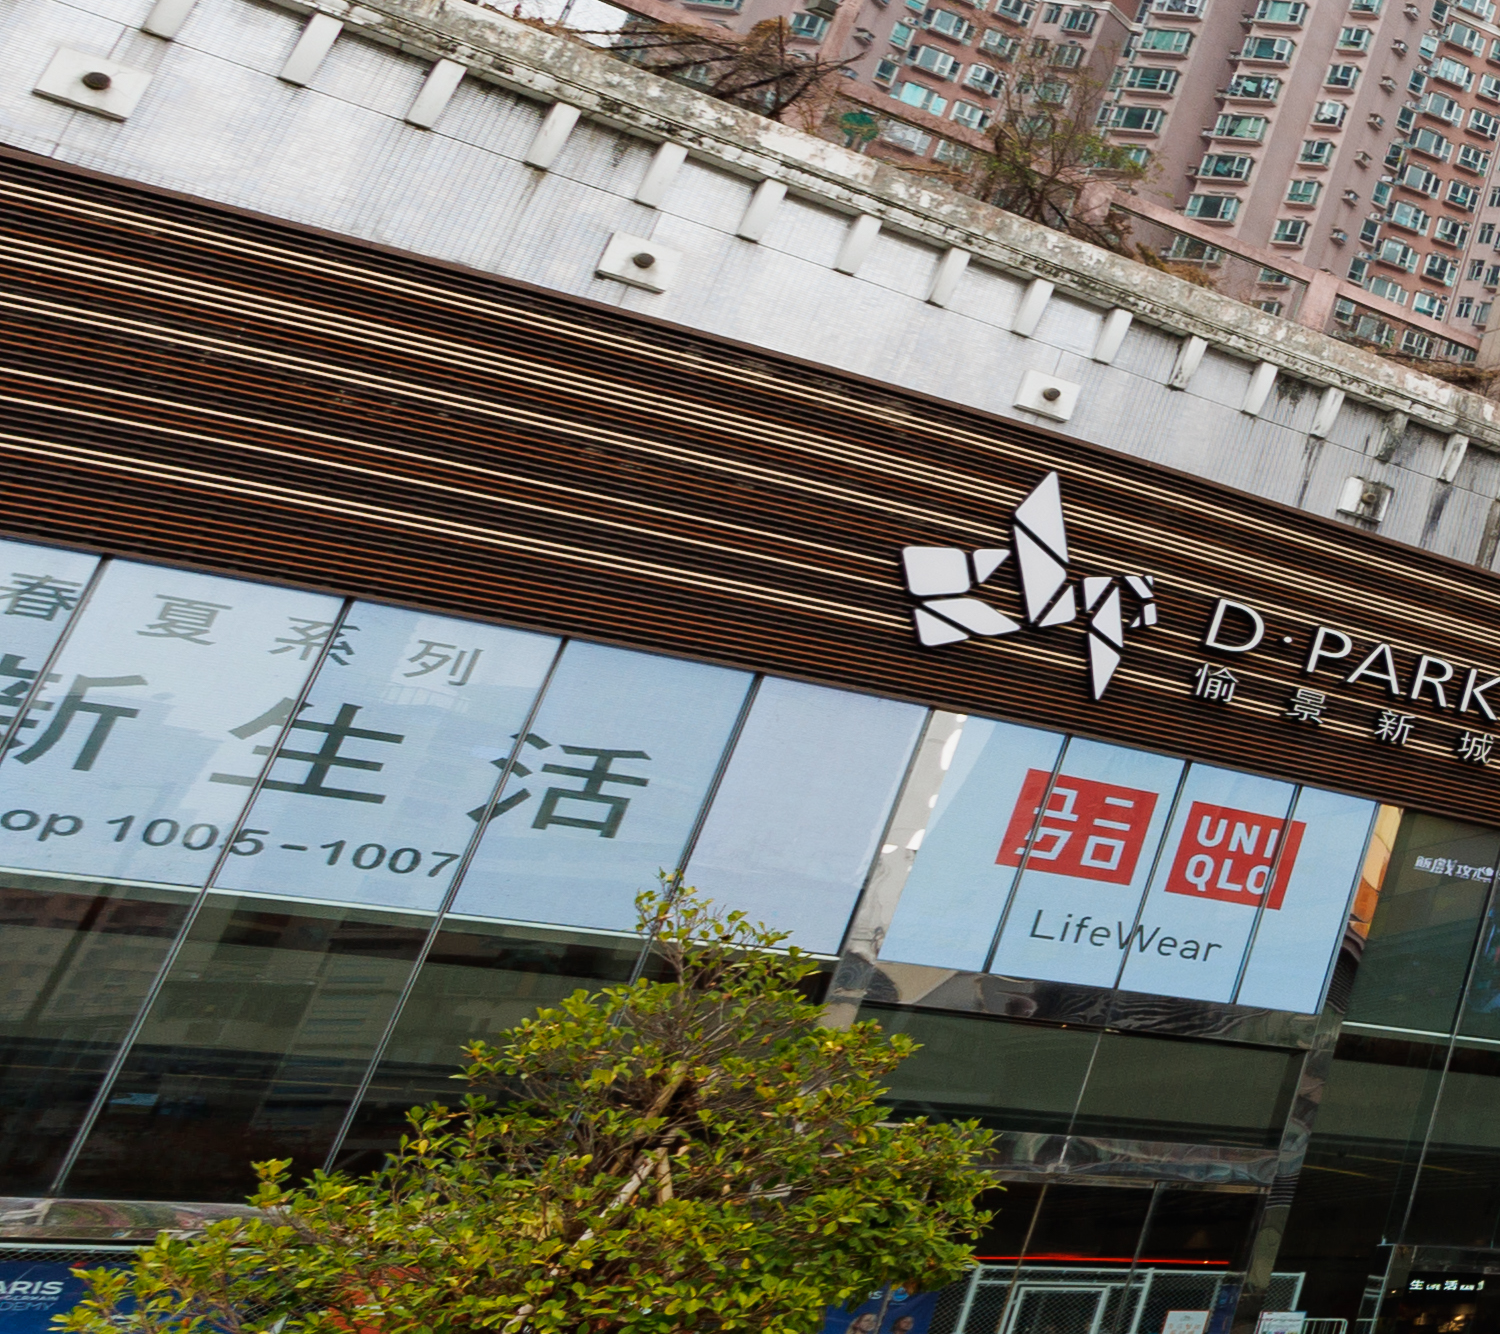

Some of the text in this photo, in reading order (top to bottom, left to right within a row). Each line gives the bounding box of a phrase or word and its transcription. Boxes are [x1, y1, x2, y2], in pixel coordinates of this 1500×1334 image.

[0, 573, 483, 686] 春夏系列
[1195, 662, 1496, 765] 愉景新城
[1197, 814, 1281, 858] UNI
[1185, 854, 1273, 896] QLO
[1029, 909, 1222, 965] LifeWear
